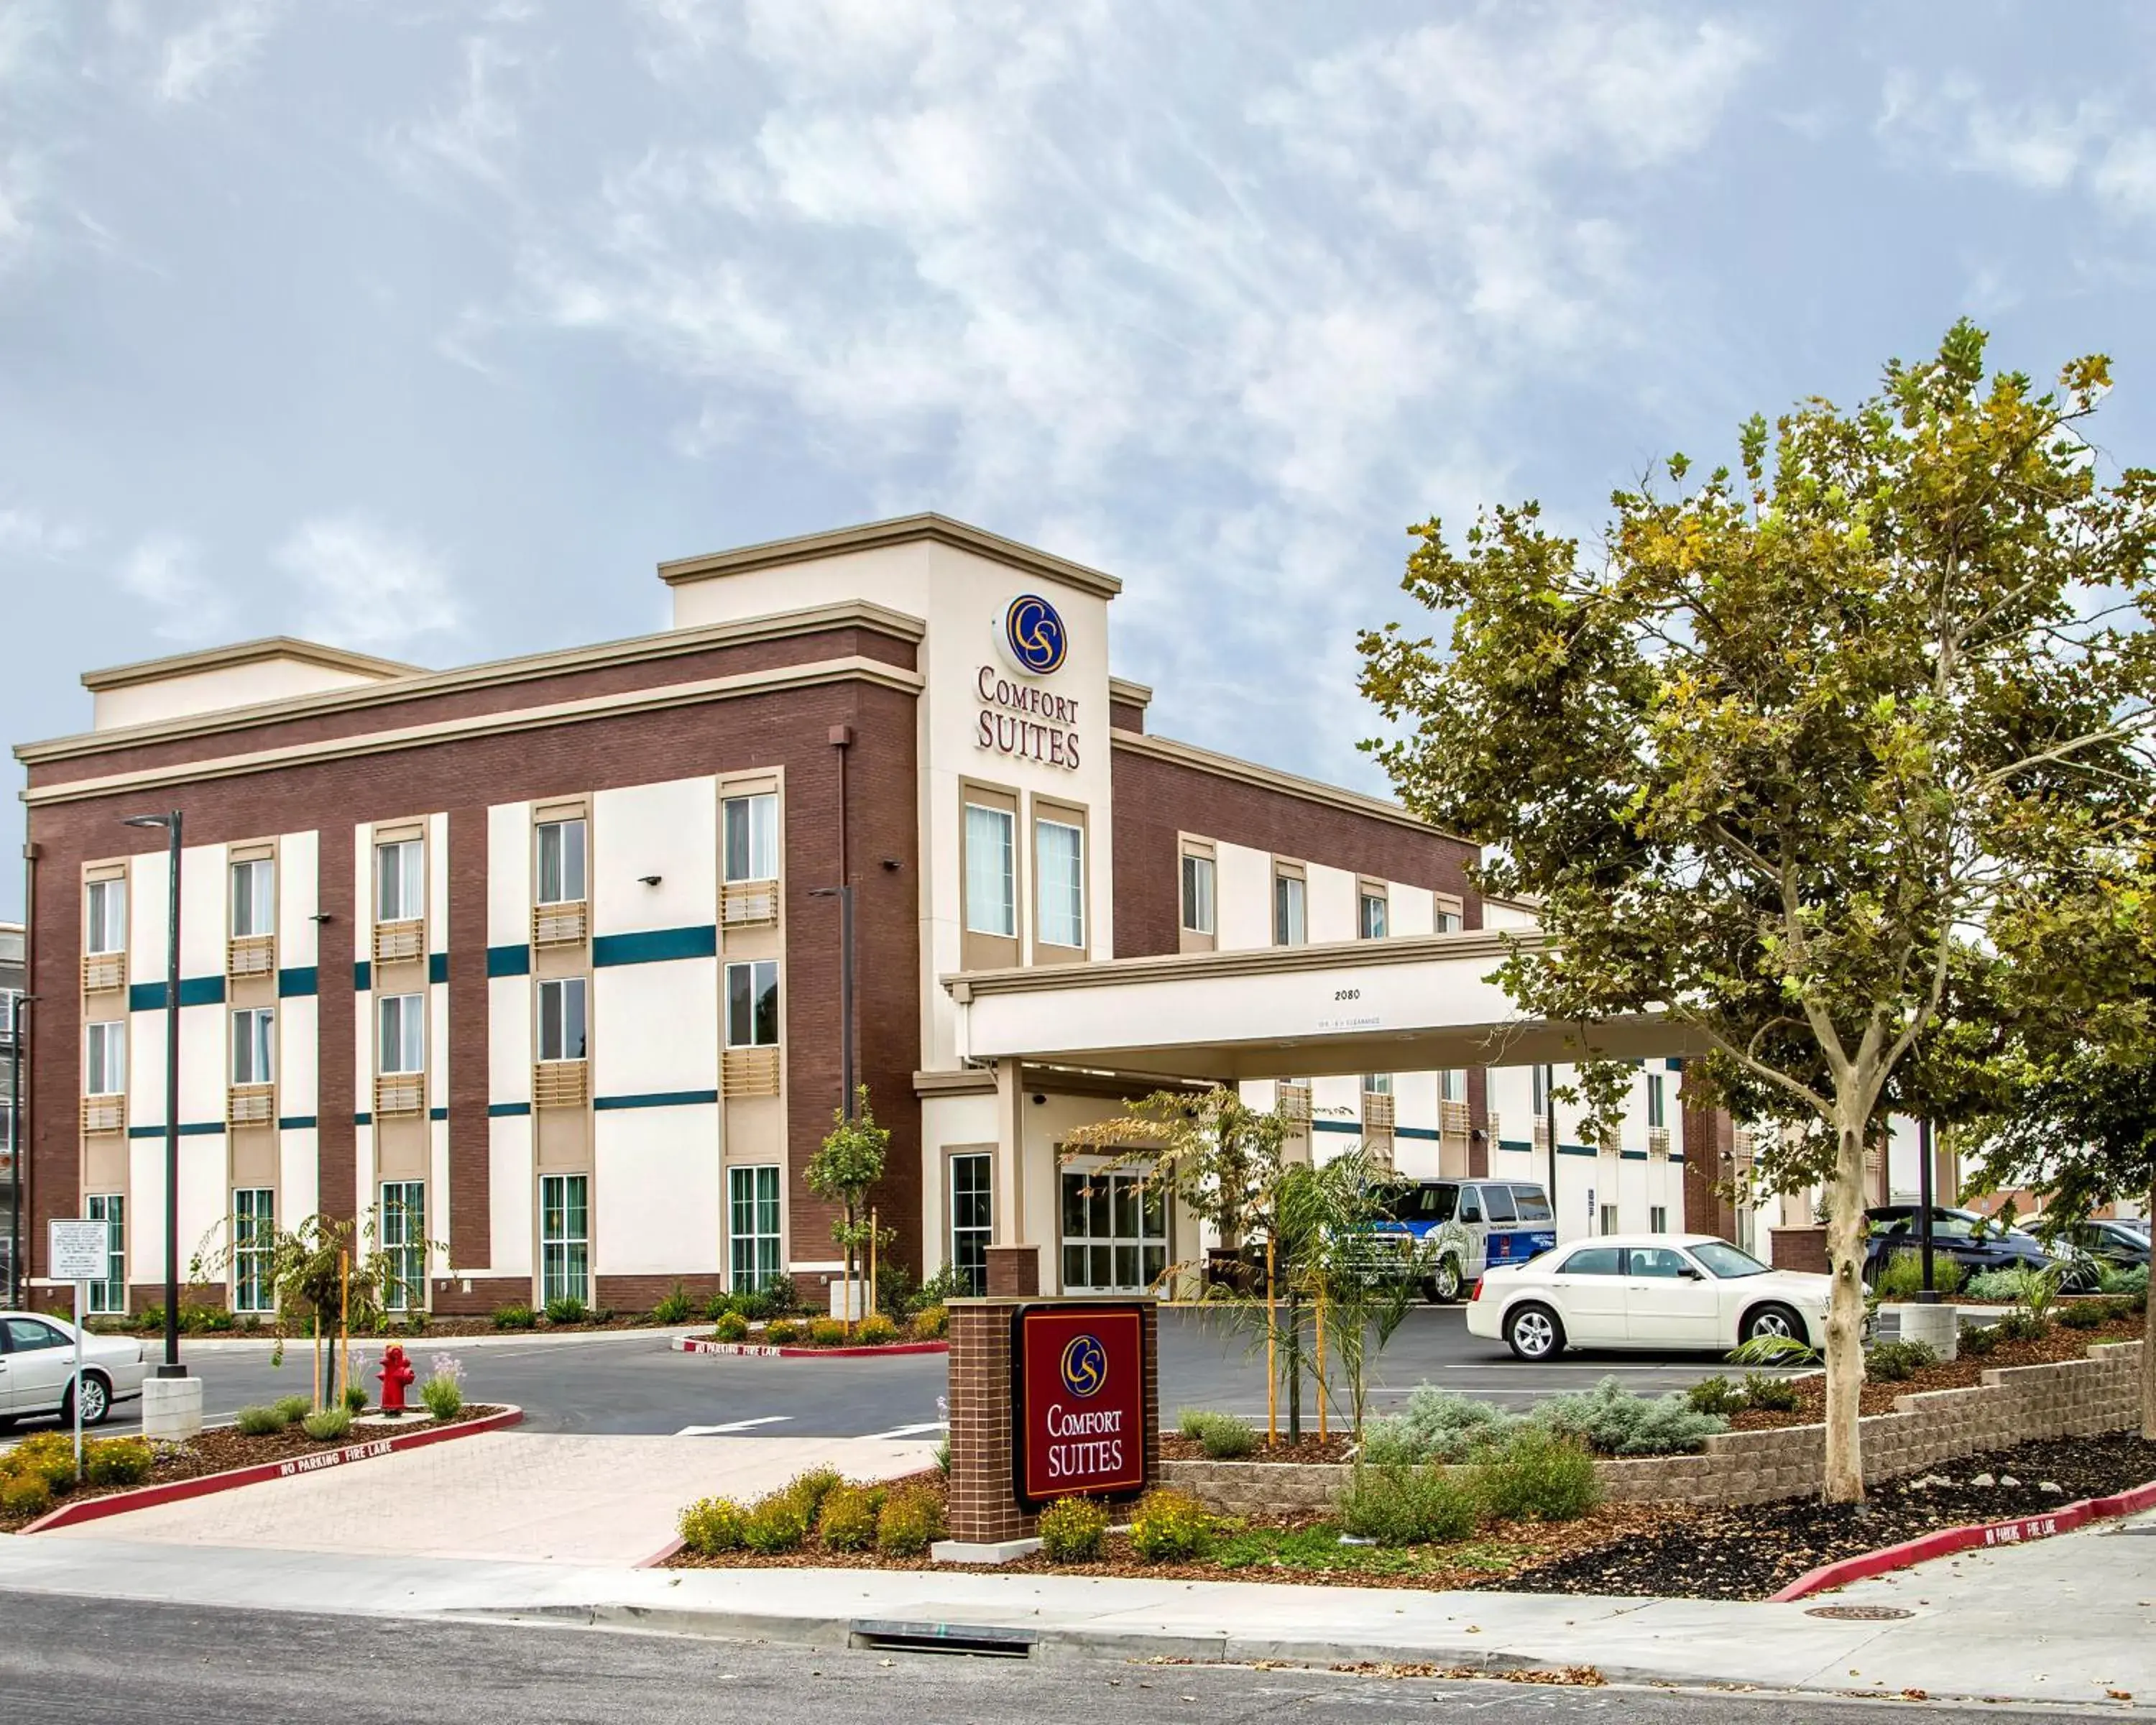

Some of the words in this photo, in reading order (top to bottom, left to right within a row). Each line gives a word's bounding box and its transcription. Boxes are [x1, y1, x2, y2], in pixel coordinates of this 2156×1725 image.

[980, 710, 1079, 769] SUITES
[1335, 989, 1360, 1000] 2080
[1047, 1404, 1122, 1438] COMFORT
[281, 1462, 295, 1476] NO
[298, 1452, 339, 1472] PARKING
[344, 1446, 366, 1461] FIRE
[367, 1442, 392, 1457] LANE
[1049, 1440, 1122, 1478] SUITES
